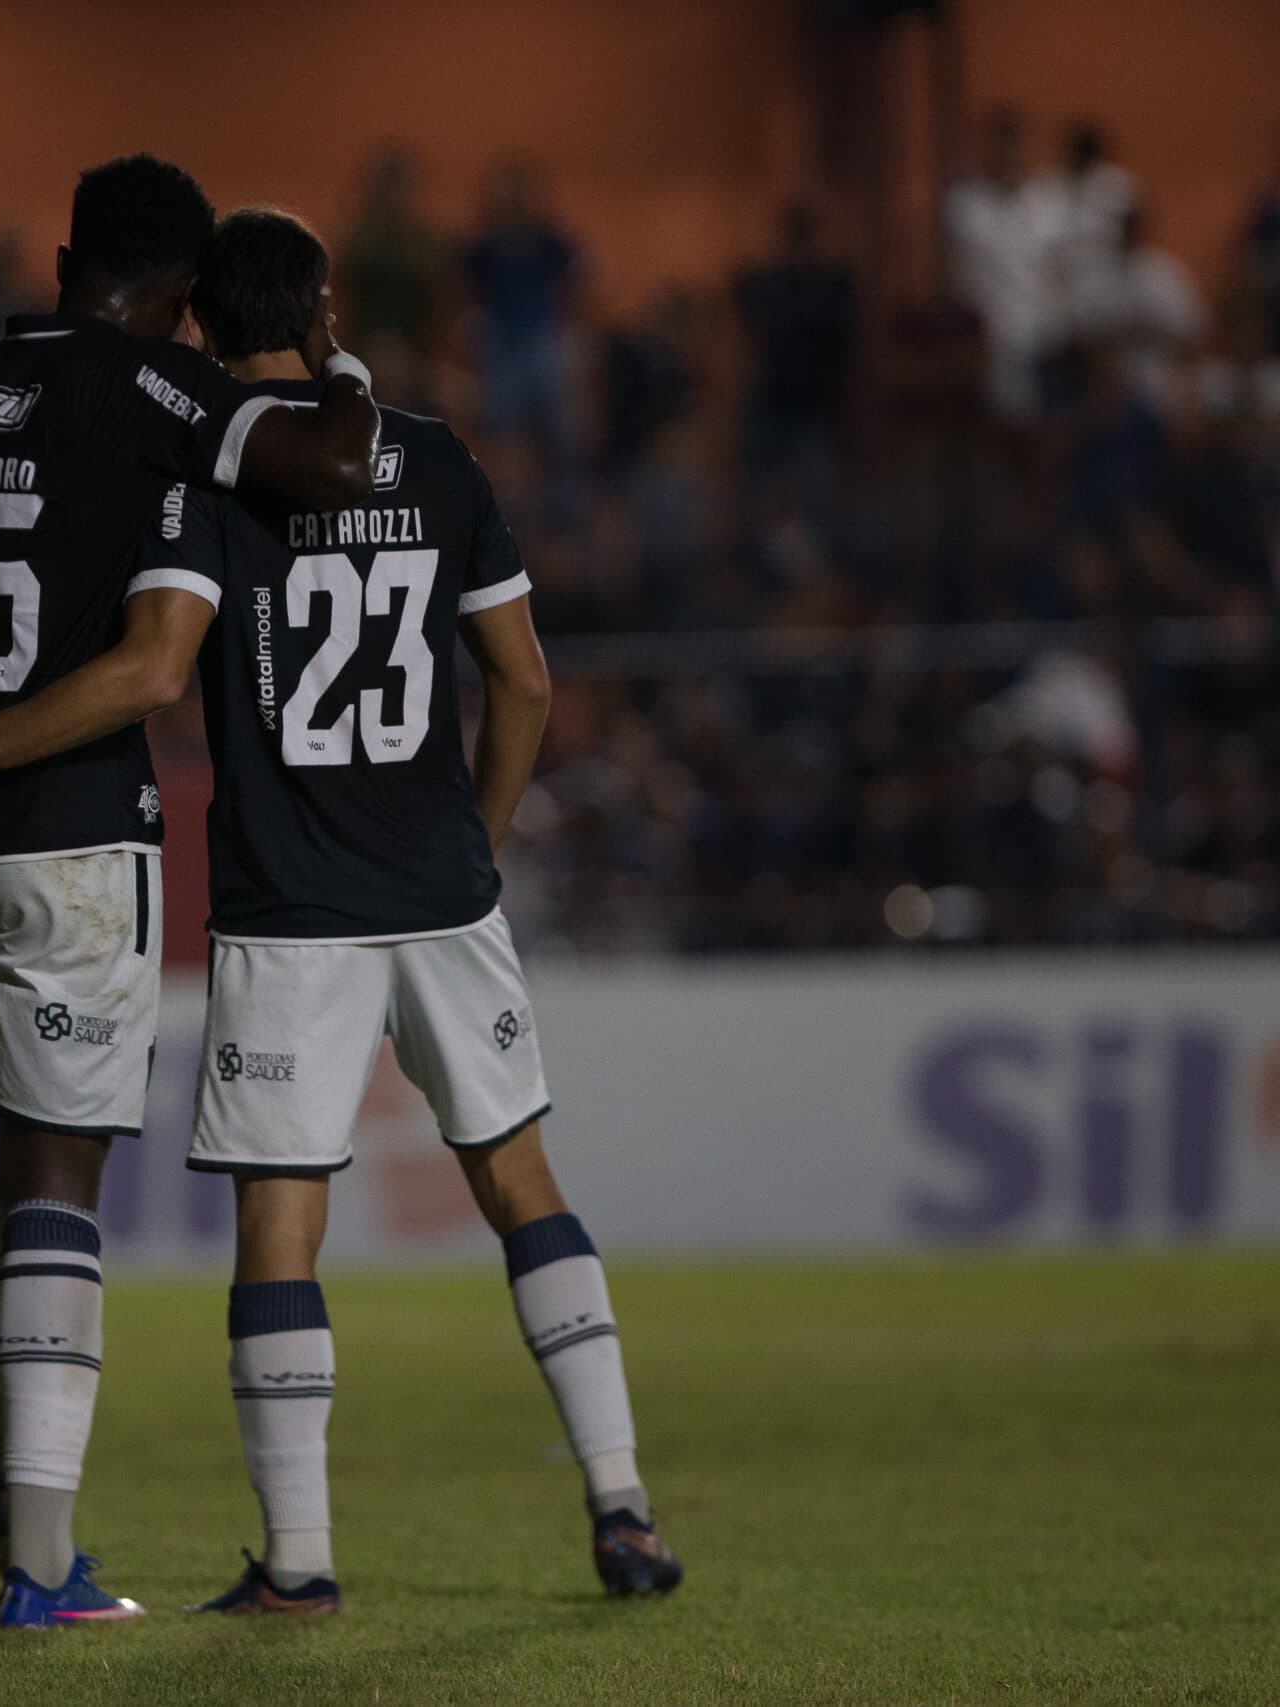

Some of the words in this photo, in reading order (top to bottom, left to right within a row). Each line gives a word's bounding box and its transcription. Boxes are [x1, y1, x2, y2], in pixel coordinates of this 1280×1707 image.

[135, 364, 208, 427] VAIDEBET
[162, 483, 187, 540] VAIDE
[288, 507, 423, 548] CATAROZZI
[253, 587, 275, 706] fatalmodel
[282, 549, 439, 766] 23
[307, 741, 326, 751] VOLT
[382, 738, 402, 747] VOLT
